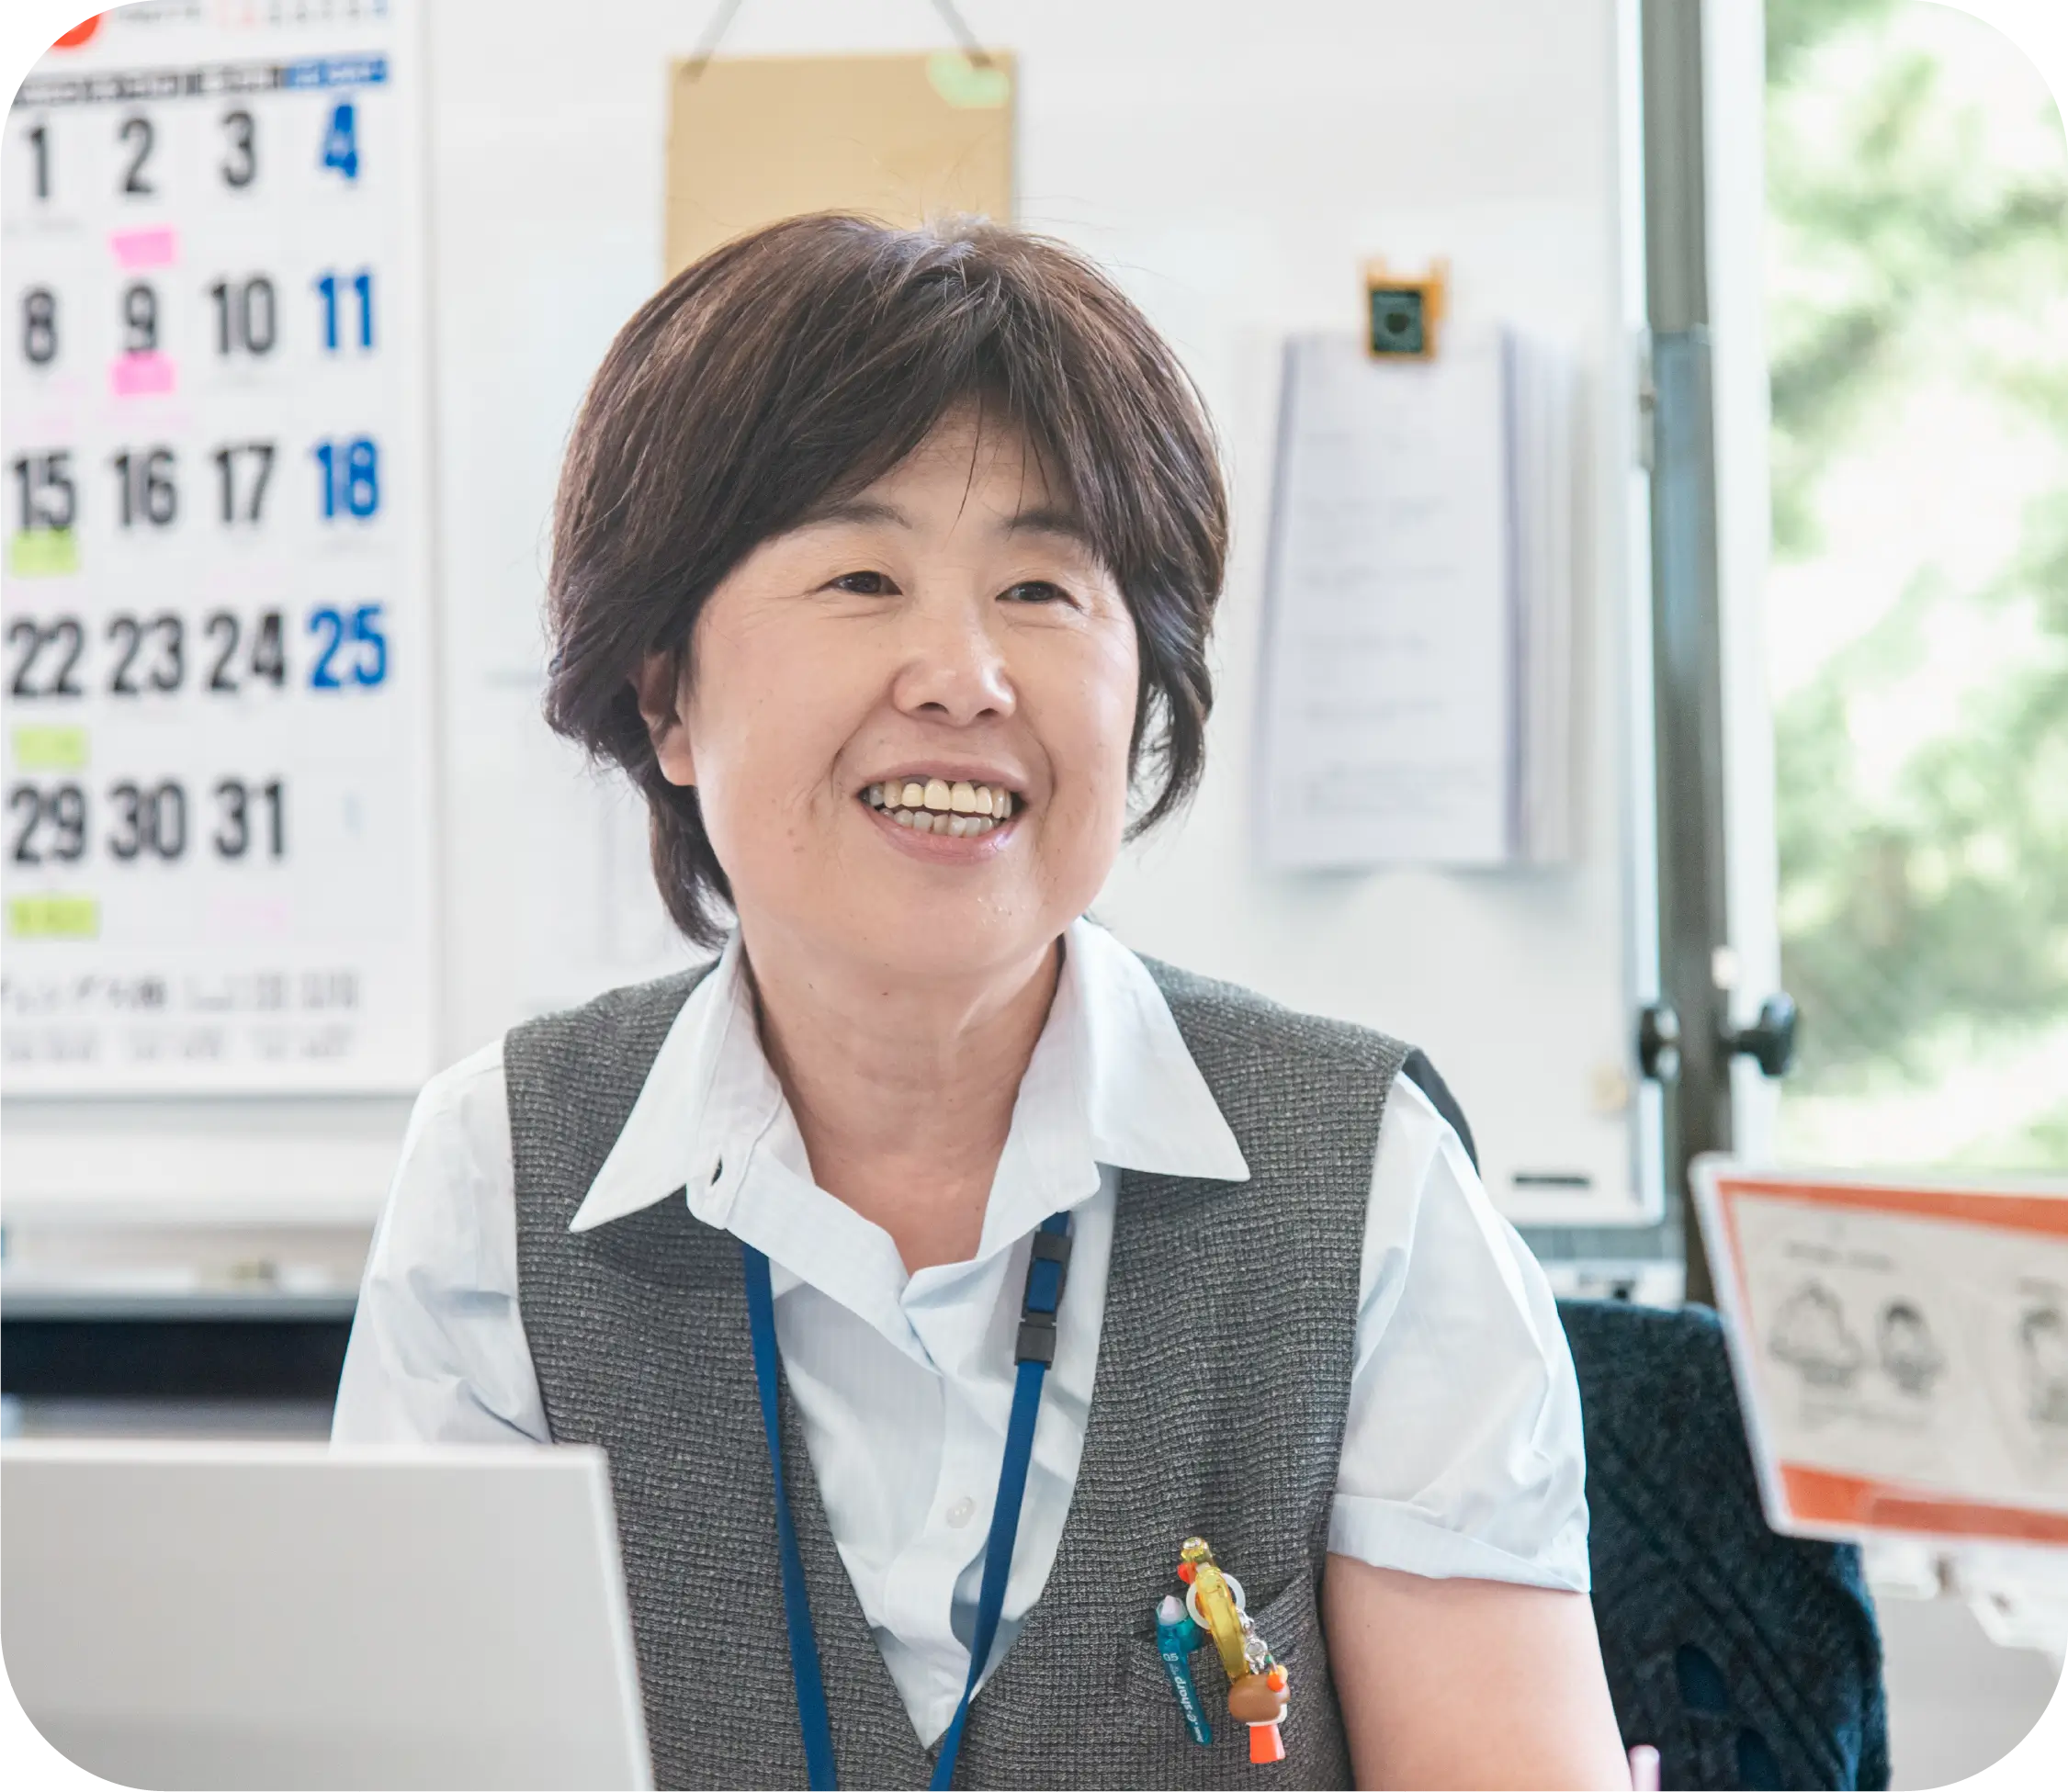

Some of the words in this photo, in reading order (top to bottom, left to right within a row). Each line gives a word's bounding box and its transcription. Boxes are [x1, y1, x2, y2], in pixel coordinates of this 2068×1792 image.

[26, 125, 48, 198] 1
[119, 115, 154, 196] 2
[222, 108, 257, 190] 3
[322, 101, 359, 179] 4
[23, 287, 58, 367] 8
[123, 282, 159, 356] 9
[210, 276, 277, 357] 10
[316, 272, 373, 350] 11
[12, 450, 77, 531] 15
[112, 446, 178, 529] 16
[212, 442, 277, 524] 17
[314, 438, 380, 520] 18
[6, 615, 85, 701] 22
[107, 613, 186, 698] 23
[204, 609, 288, 694] 24
[309, 605, 389, 689] 25
[7, 782, 88, 867] 29
[108, 779, 188, 863] 30
[214, 777, 286, 862] 31
